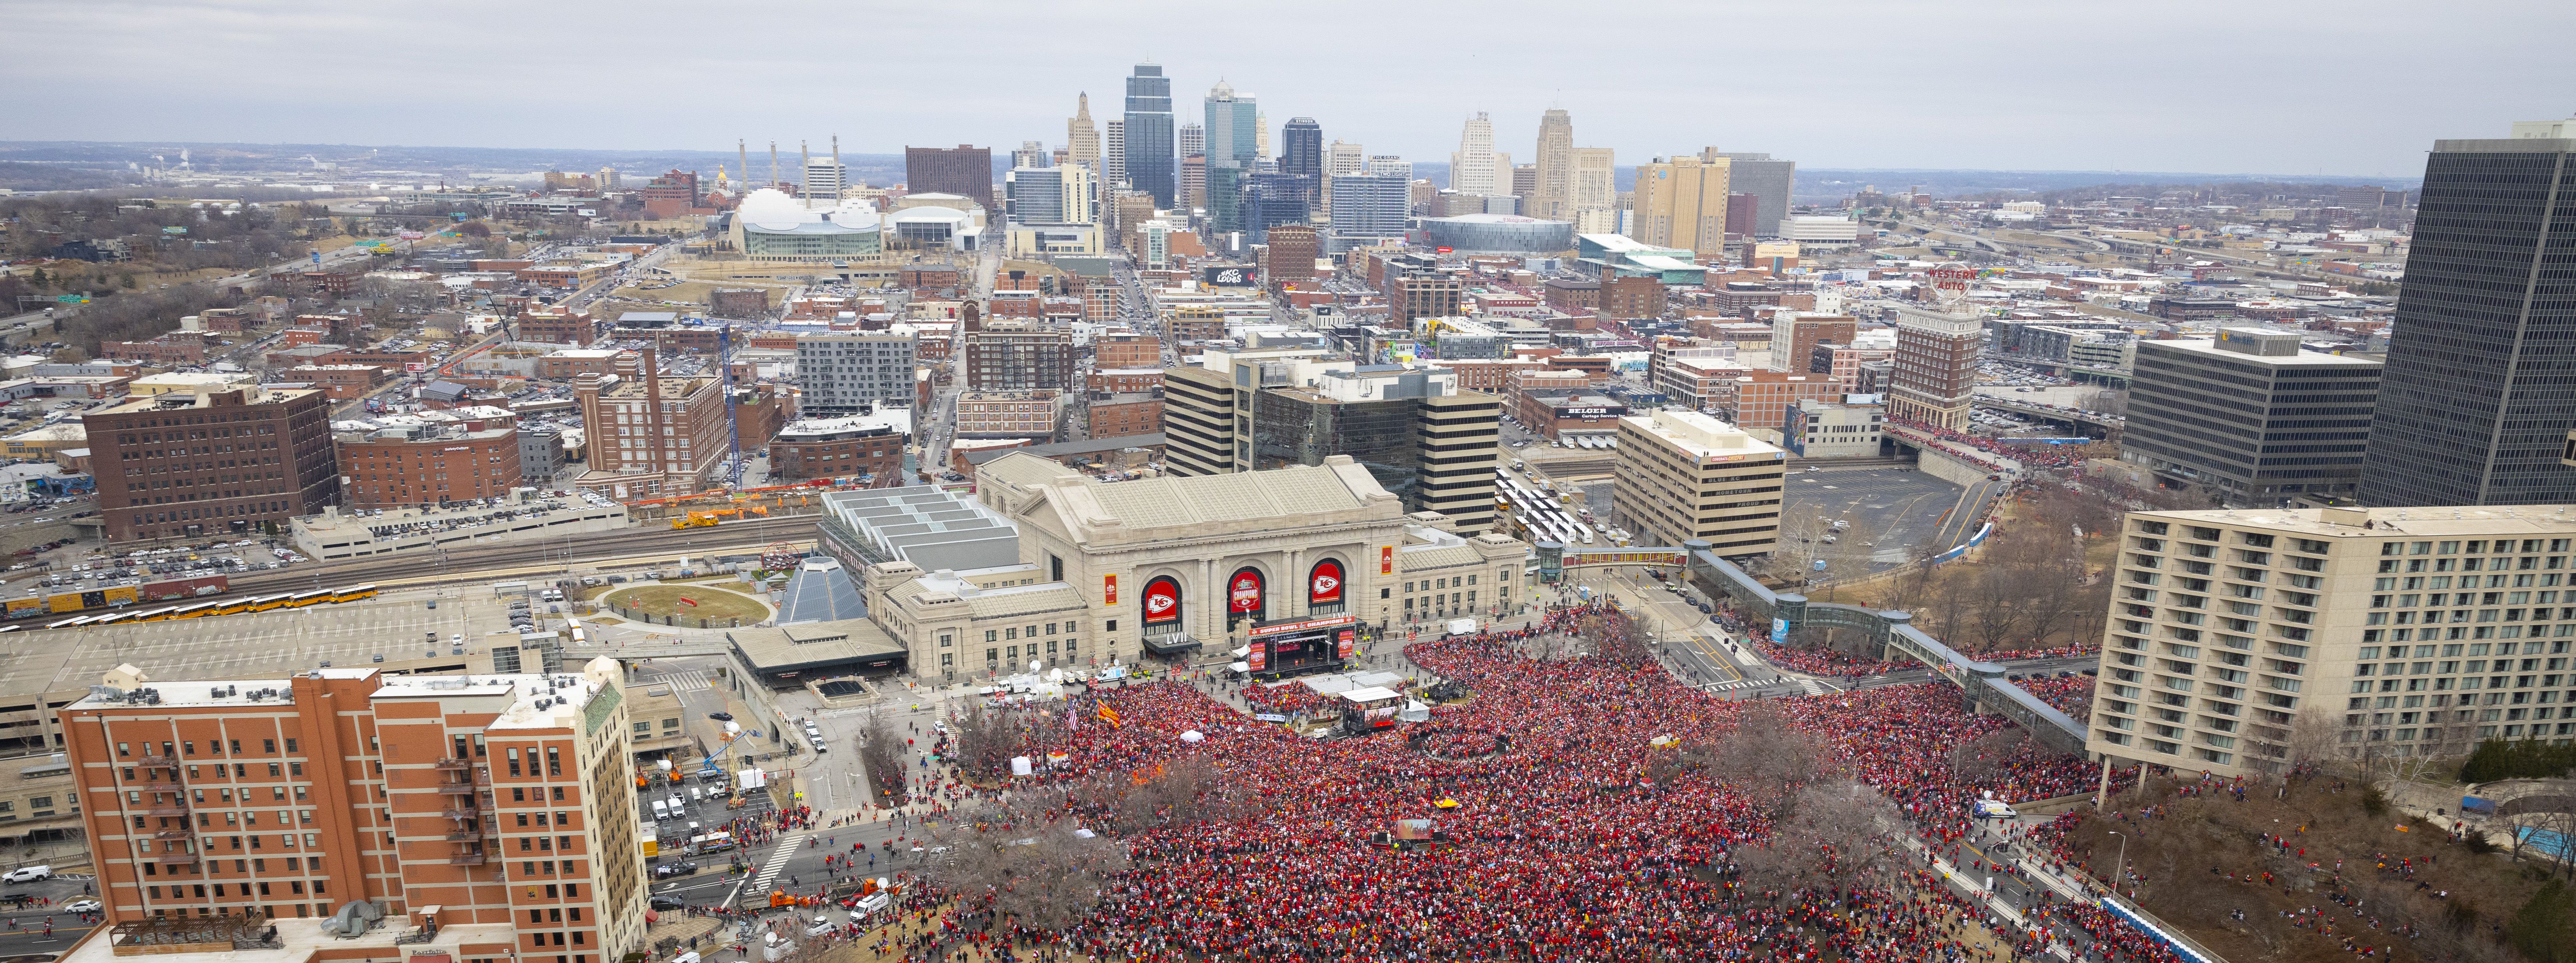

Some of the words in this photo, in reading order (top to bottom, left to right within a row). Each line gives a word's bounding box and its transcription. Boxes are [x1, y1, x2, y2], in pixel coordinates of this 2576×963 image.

[1929, 269, 1977, 280] WESTERN
[1938, 281, 1965, 291] AUTO
[826, 537, 842, 557] UNION
[844, 550, 866, 576] STATION
[1320, 579, 1333, 588] KC
[1234, 589, 1257, 601] CHAMPIONS
[1154, 598, 1168, 608] KC
[1307, 619, 1345, 628] CHAMPIONS
[1167, 632, 1187, 644] LVII
